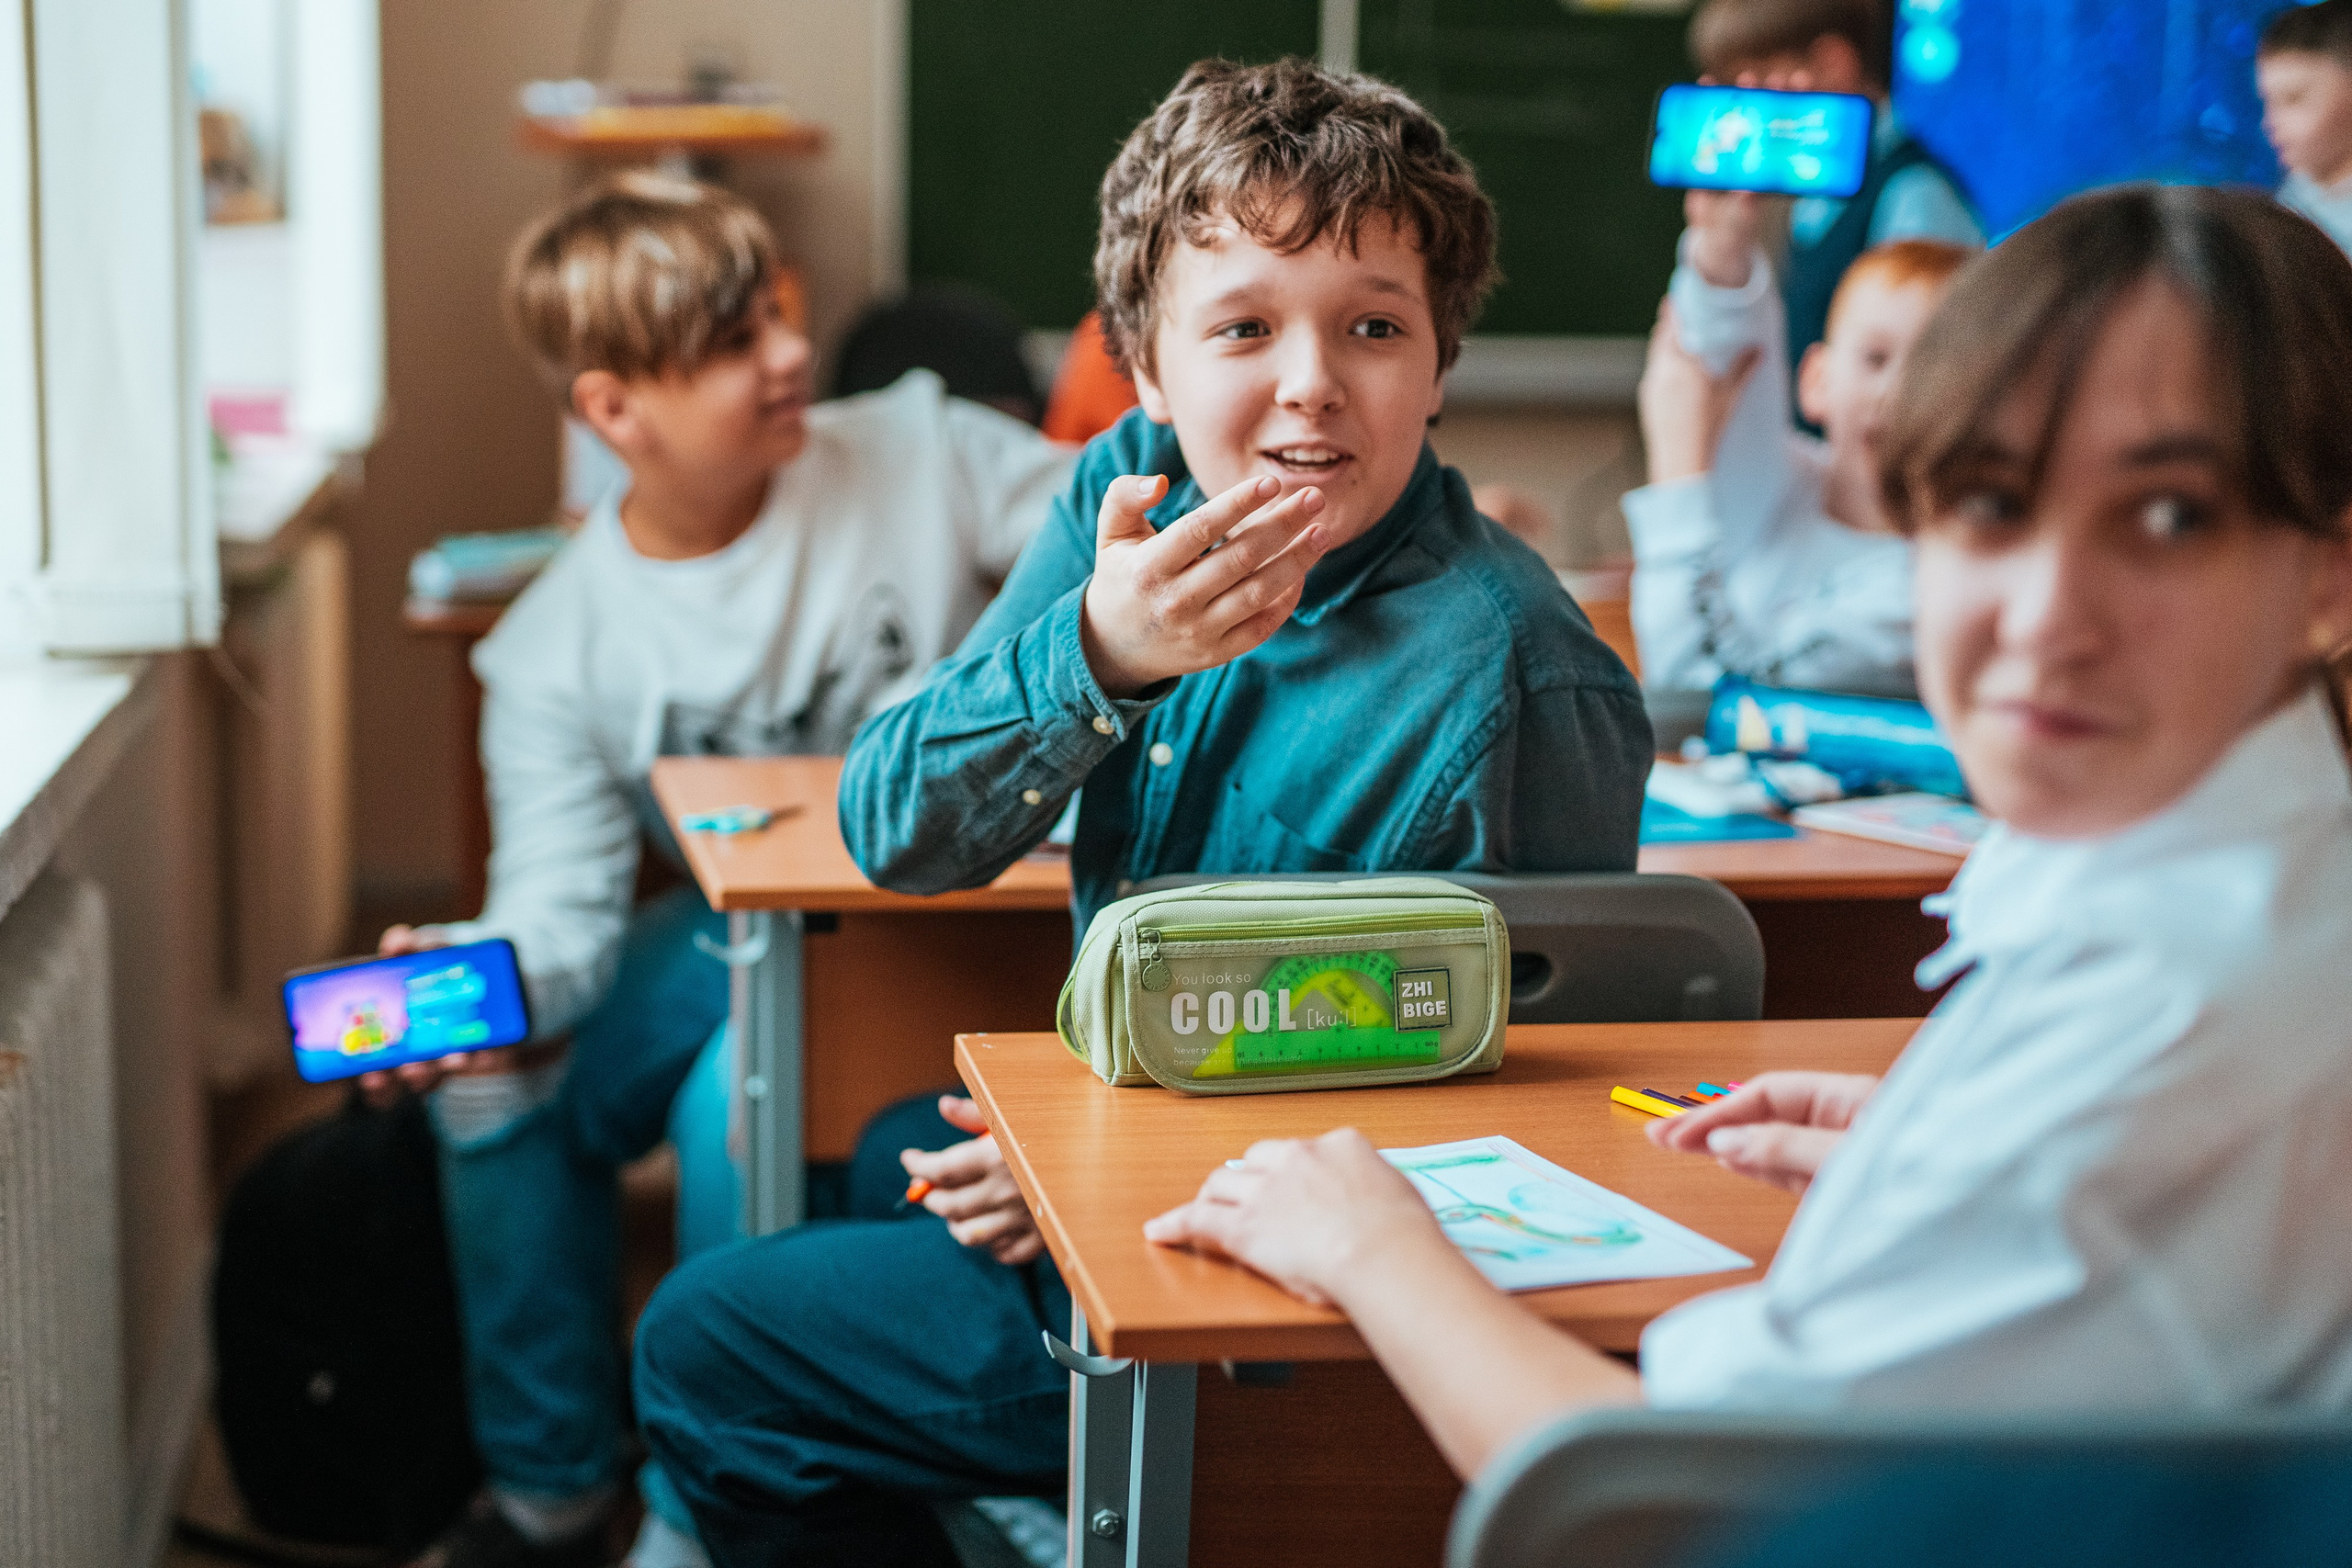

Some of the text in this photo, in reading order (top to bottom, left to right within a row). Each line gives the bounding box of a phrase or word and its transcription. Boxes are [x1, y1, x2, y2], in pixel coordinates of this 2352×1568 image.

[1172, 974, 1198, 986] You
[1202, 972, 1232, 985] look
[1236, 974, 1251, 983] so
[1402, 981, 1433, 998] ZHI
[1170, 988, 1296, 1035] COOL
[1403, 1000, 1447, 1019] BIGE
[1173, 1046, 1199, 1055] Never
[1201, 1047, 1220, 1056] give
[1173, 1058, 1210, 1066] because
